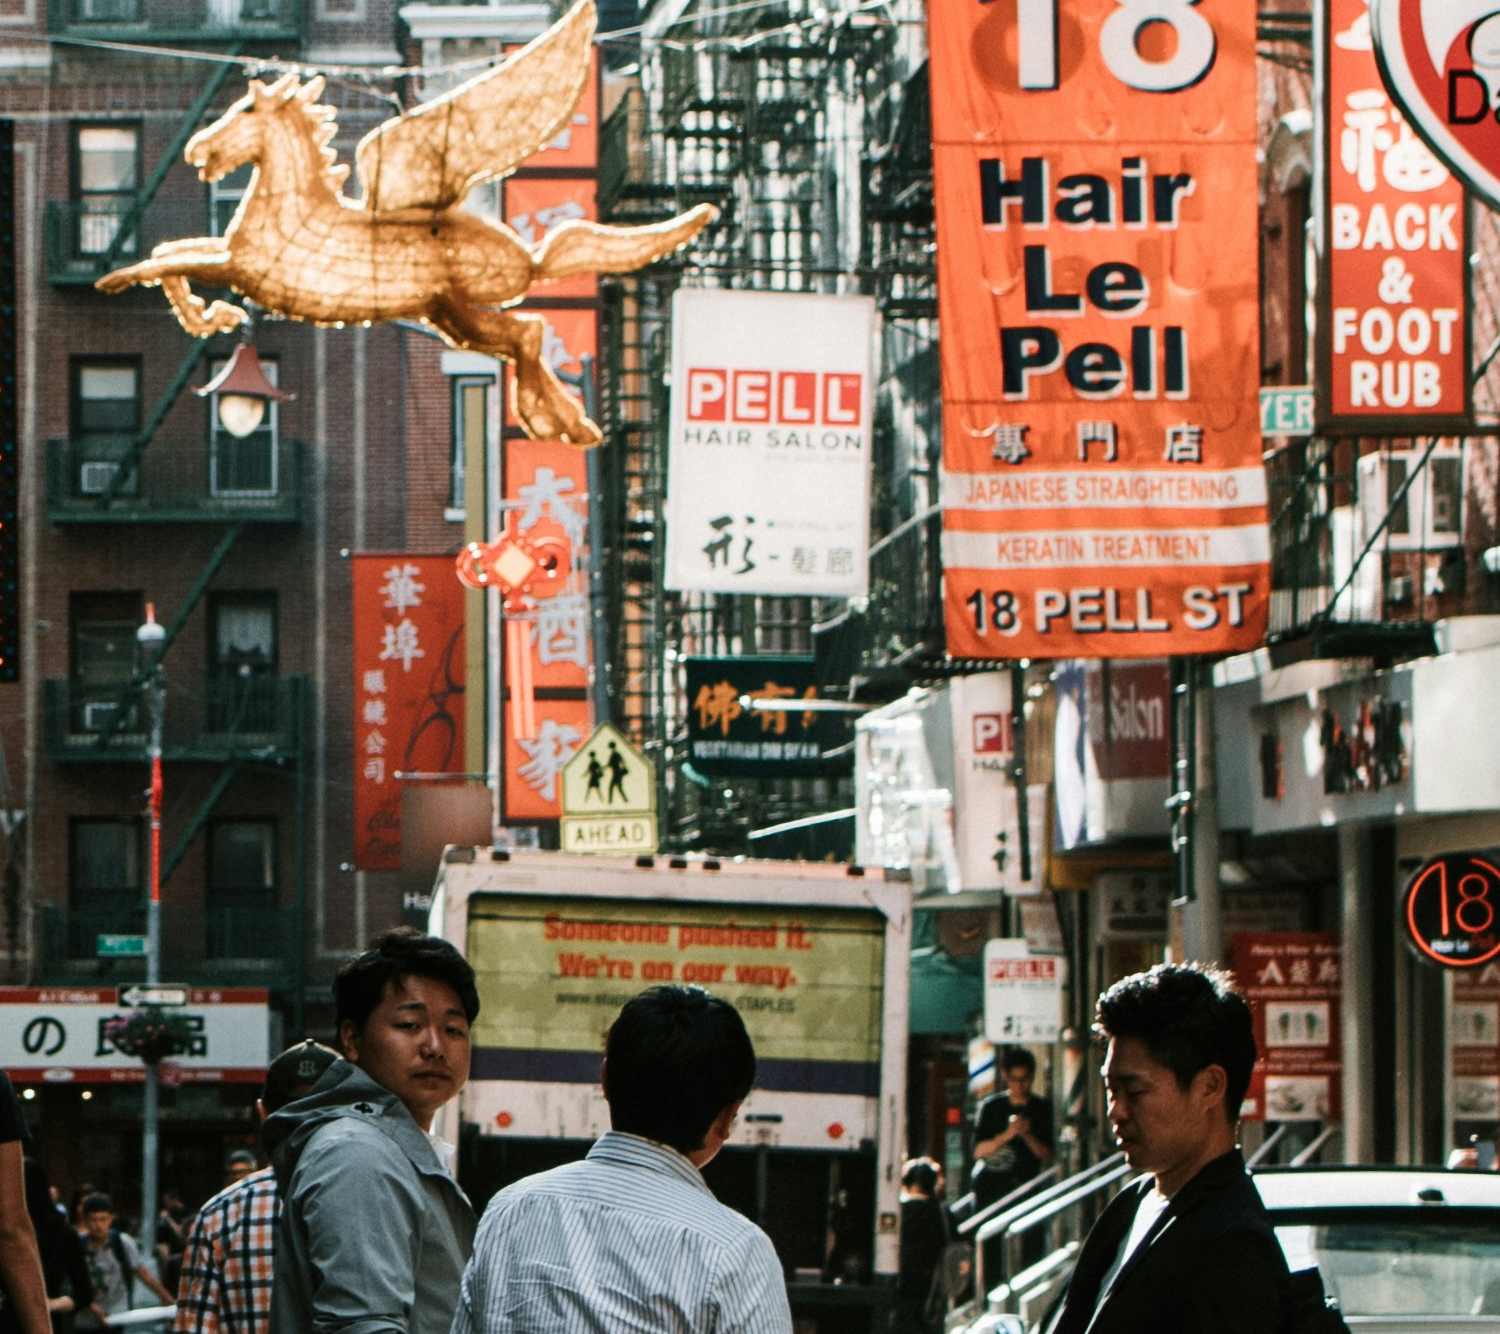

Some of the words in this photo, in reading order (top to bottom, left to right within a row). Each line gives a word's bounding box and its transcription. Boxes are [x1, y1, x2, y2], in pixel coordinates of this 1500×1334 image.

[979, 157, 1196, 230] Hair
[1332, 204, 1458, 251] BACK
[1024, 245, 1149, 319] Le
[1377, 256, 1414, 305] &
[1333, 309, 1458, 355] FOOT
[1001, 326, 1191, 401] Pell
[1350, 361, 1442, 408] RUB
[689, 372, 857, 421] PELL
[684, 428, 753, 446] HAIR
[766, 430, 863, 450] SALON
[992, 422, 1204, 464] 專門店
[966, 477, 1068, 503] JAPANESE
[1076, 476, 1239, 501] STRAIGHTENING
[997, 538, 1084, 562] KERATIN
[1092, 536, 1210, 561] TREATMENT
[966, 589, 1022, 637] 18
[1034, 586, 1171, 633] PELL
[1182, 584, 1252, 630] ST
[574, 825, 645, 845] AHEAD
[544, 913, 670, 944] Someone
[678, 920, 778, 951] pushed
[786, 921, 813, 950] it.
[558, 952, 634, 979] We're
[640, 959, 674, 981] on
[682, 961, 728, 984] our
[735, 965, 797, 991] way.
